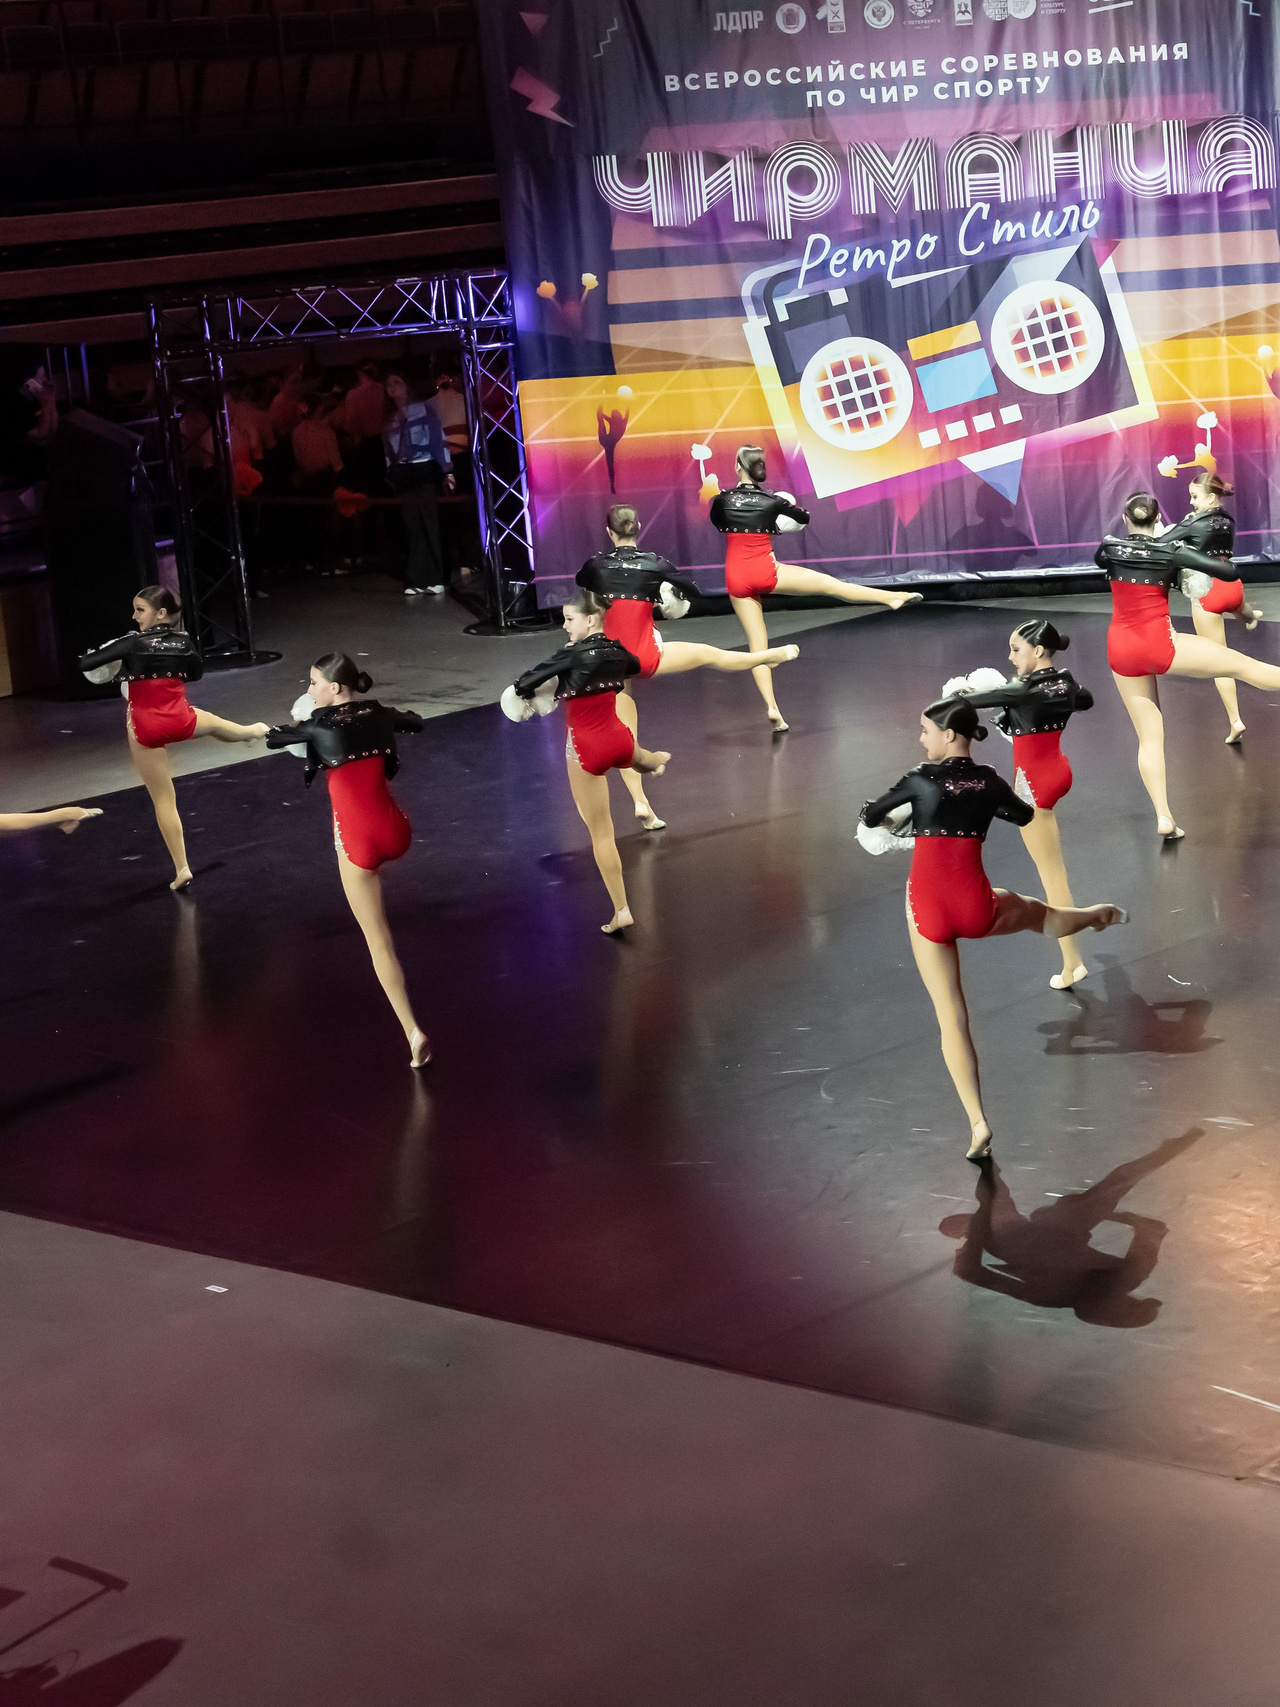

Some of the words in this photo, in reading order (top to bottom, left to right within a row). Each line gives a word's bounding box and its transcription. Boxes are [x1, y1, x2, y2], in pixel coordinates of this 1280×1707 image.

[713, 10, 764, 34] ЛДПР
[664, 59, 927, 92] ВСЕРОССИЙСКИЕ
[940, 42, 1190, 75] СОРЕВНОВАНИЯ
[806, 89, 846, 108] ПО
[859, 84, 920, 104] ЧИР
[933, 75, 1052, 100] СПОРТУ
[797, 232, 939, 289] Ретро
[957, 200, 1102, 257] Стиль
